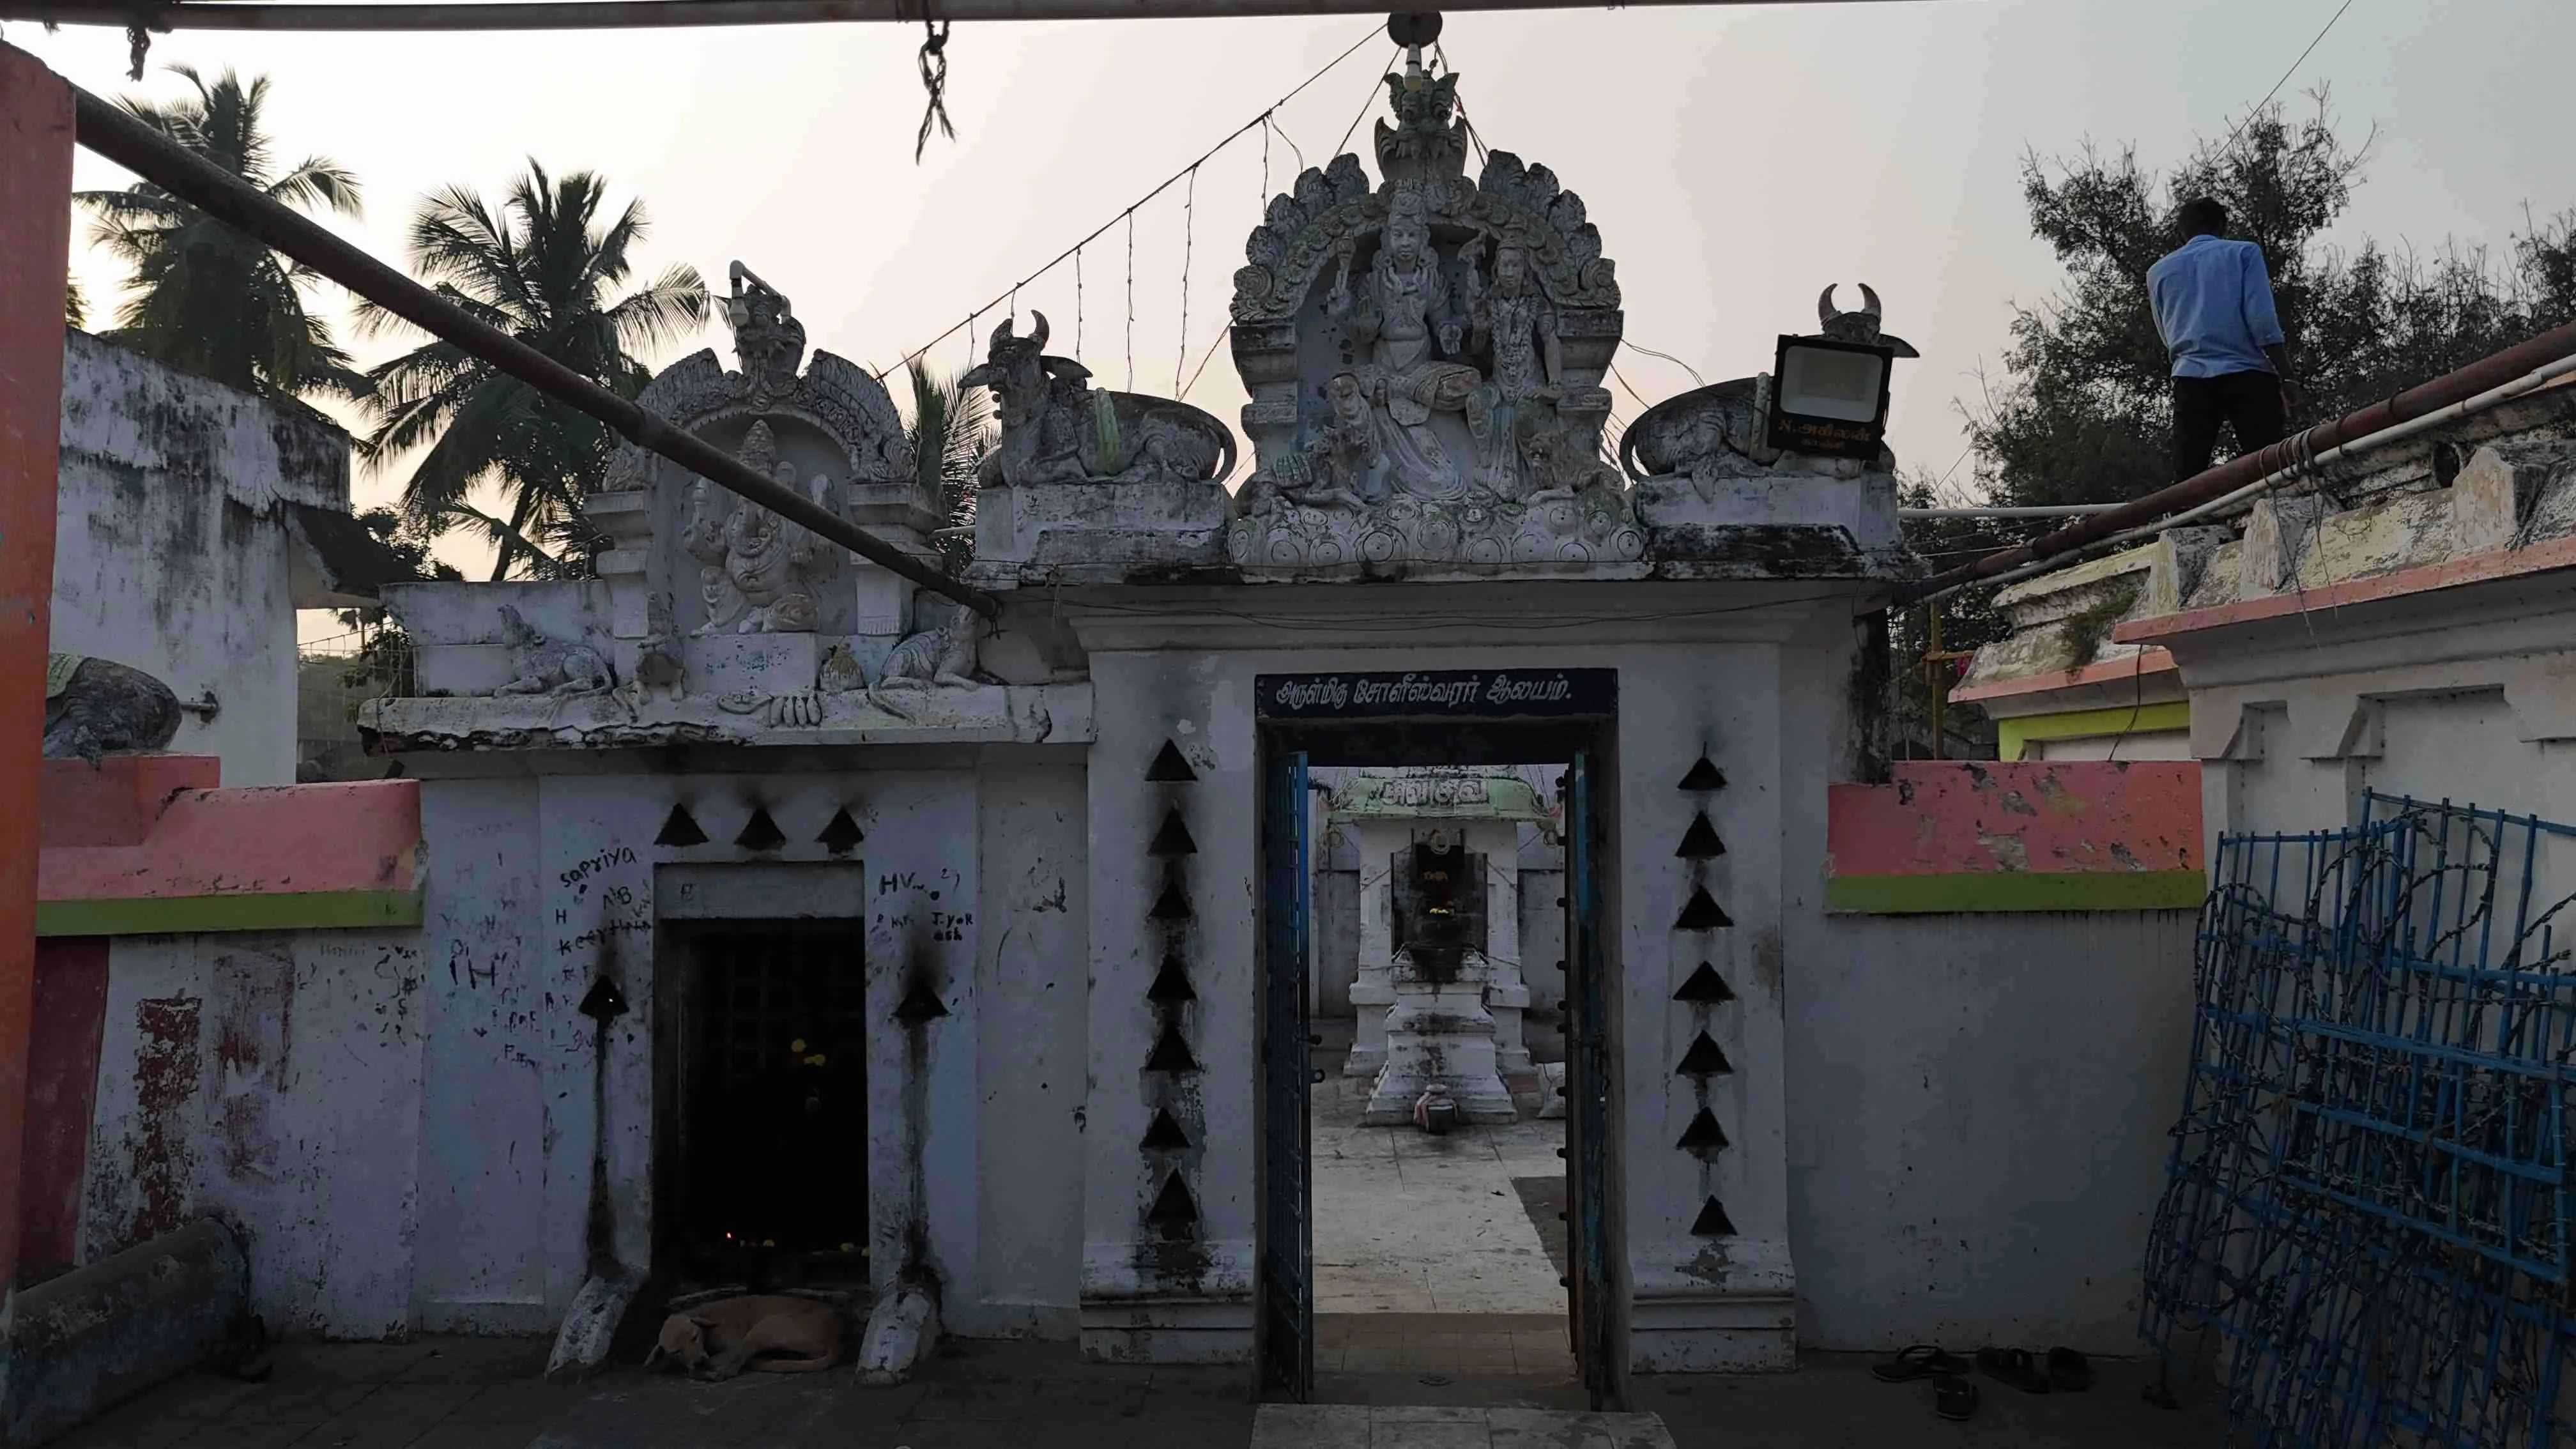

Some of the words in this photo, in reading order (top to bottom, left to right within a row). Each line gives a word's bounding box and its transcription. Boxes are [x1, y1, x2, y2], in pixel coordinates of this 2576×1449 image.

[1276, 677, 1348, 710] அருள்மிகு
[1353, 673, 1480, 708] சோளீஸ்வரர்
[1486, 675, 1572, 705] ஆலயம்.
